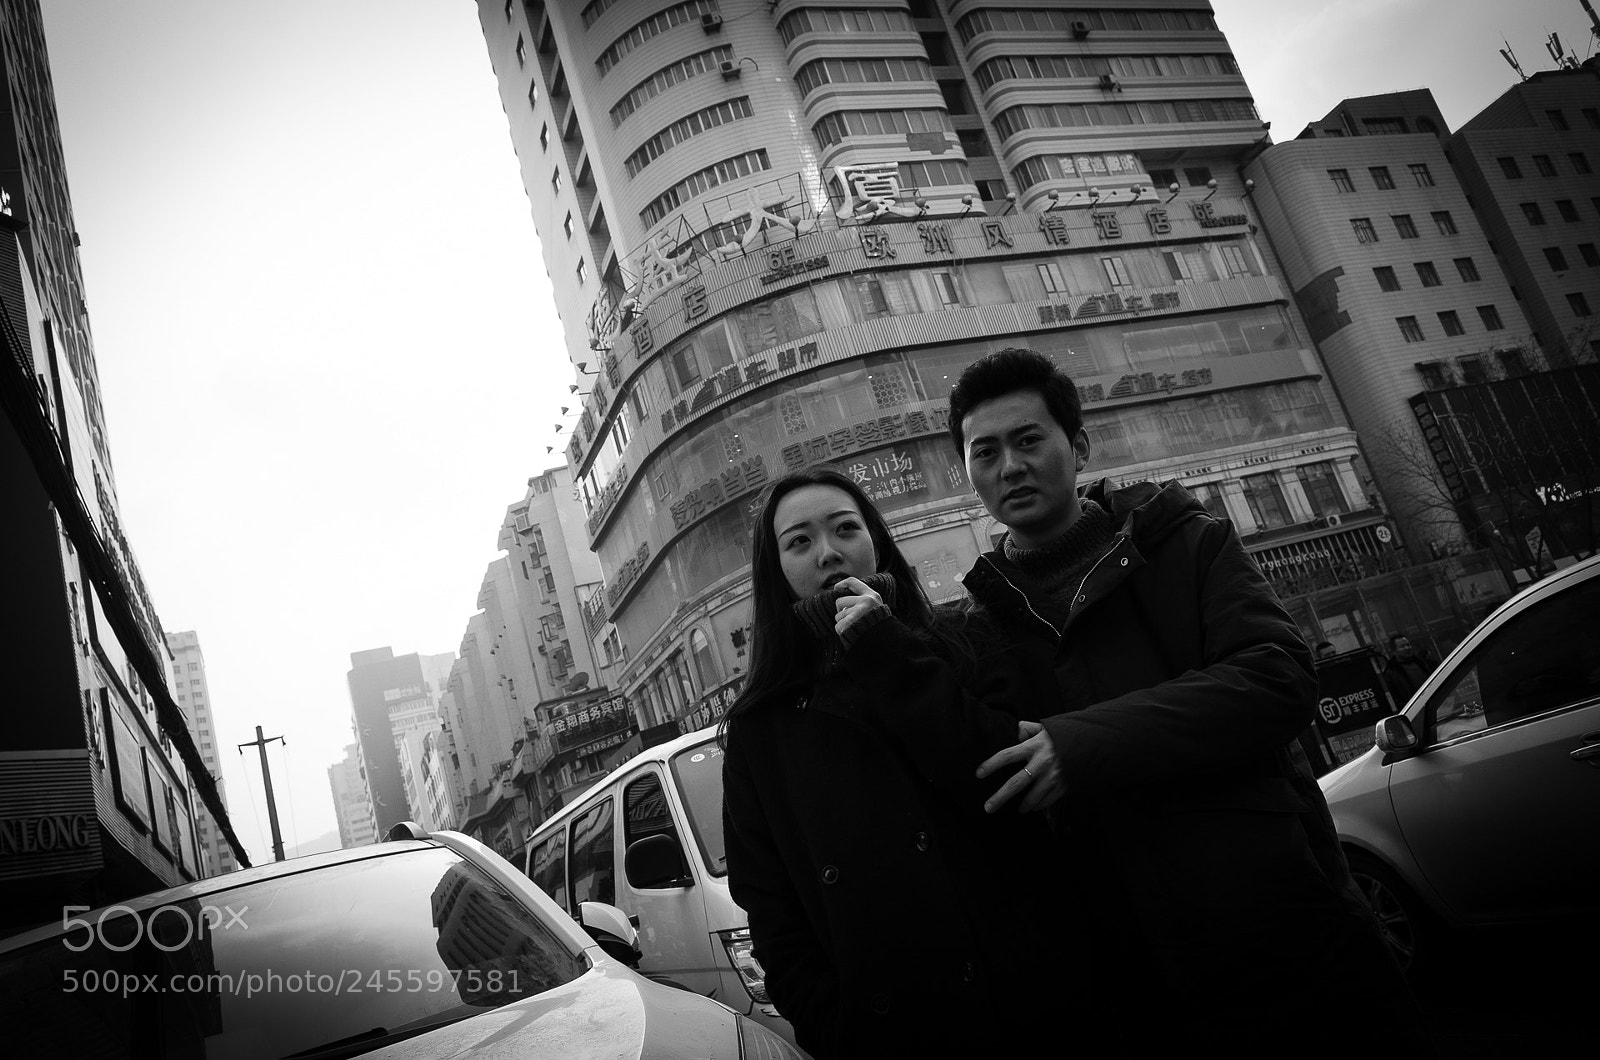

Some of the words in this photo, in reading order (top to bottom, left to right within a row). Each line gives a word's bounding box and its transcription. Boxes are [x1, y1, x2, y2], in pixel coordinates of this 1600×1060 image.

[1193, 203, 1213, 222] 6F
[861, 207, 1172, 260] 欧洲风情酒店
[766, 246, 796, 271] 6F
[838, 451, 913, 485] 发市场
[1338, 688, 1375, 707] EXPRESS
[554, 697, 624, 733] 金翔商务宾馆
